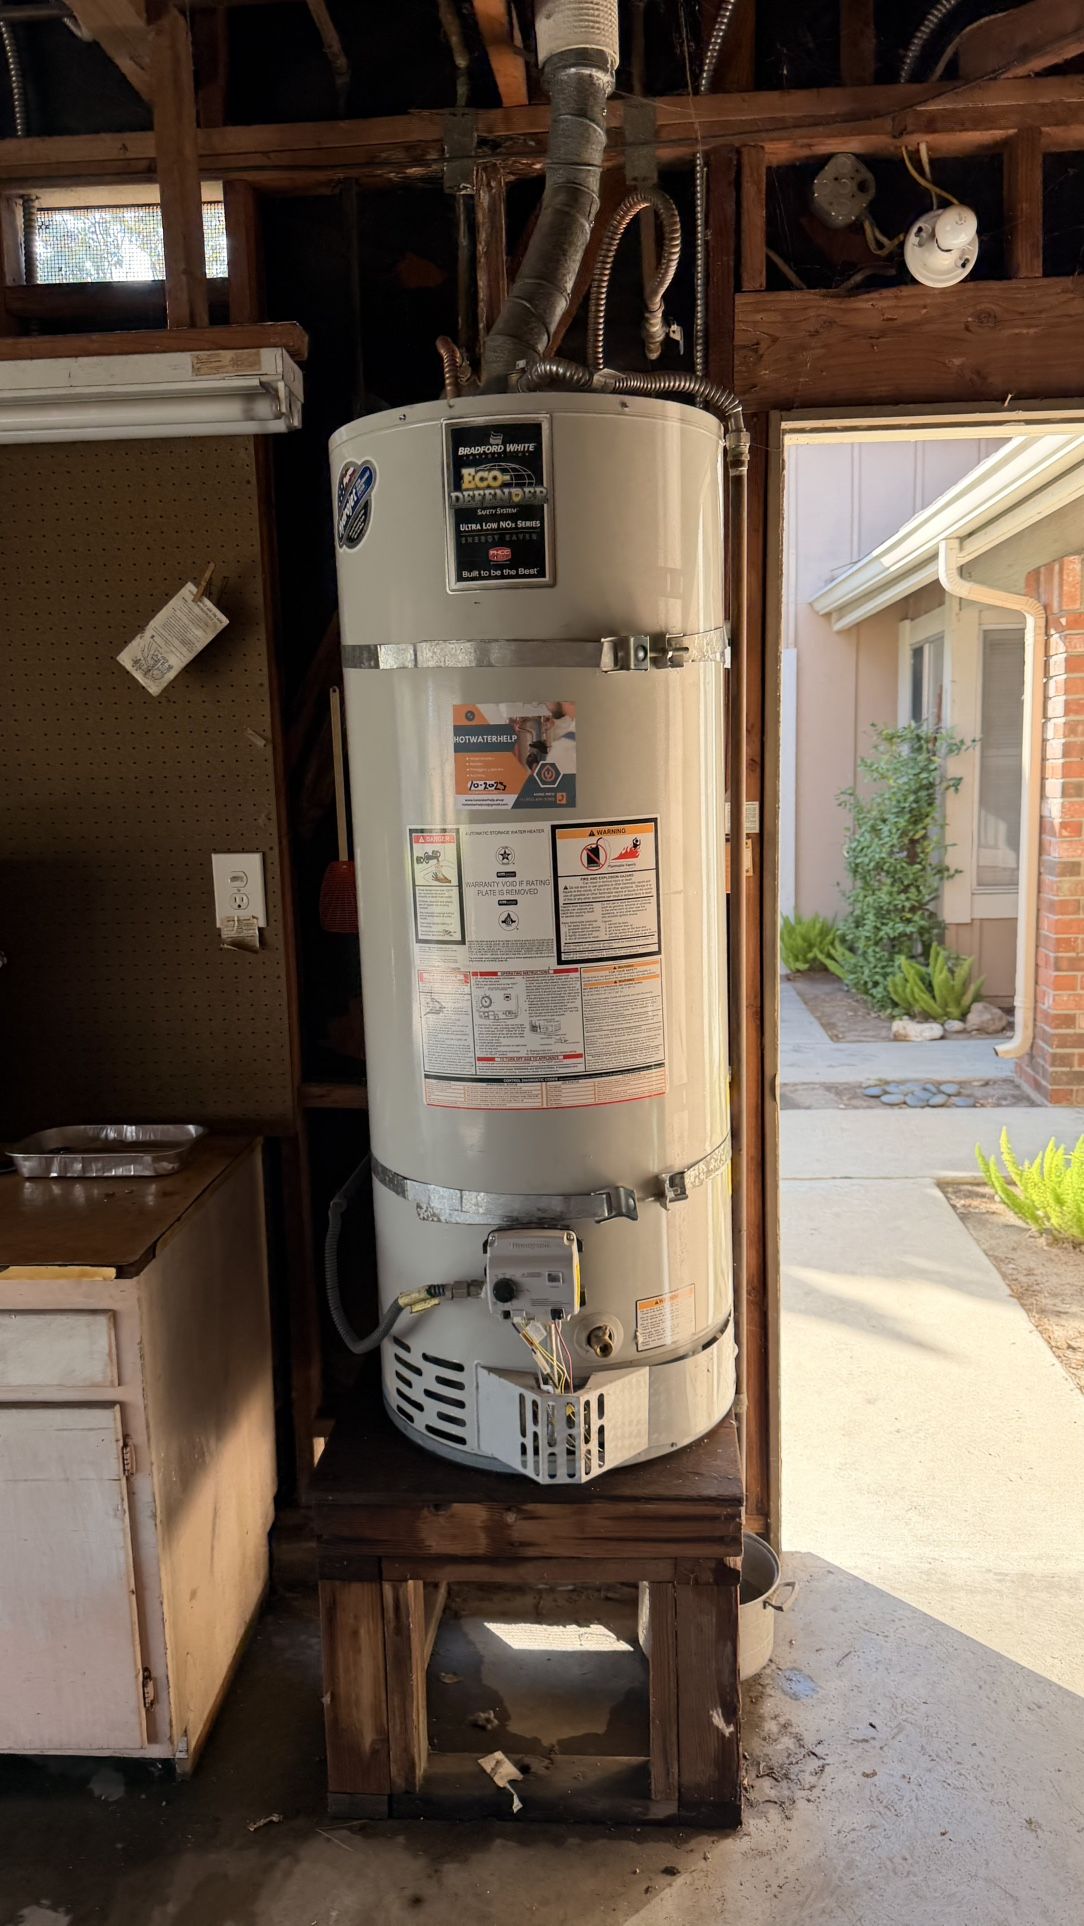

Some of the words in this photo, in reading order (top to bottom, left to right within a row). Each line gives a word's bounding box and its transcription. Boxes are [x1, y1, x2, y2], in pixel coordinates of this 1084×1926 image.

[458, 445, 504, 456] BRADFORD
[506, 443, 535, 452] WHITE
[450, 487, 548, 508] DEFENDER
[482, 522, 498, 530] LOW
[517, 520, 541, 528] SERIES
[462, 570, 479, 578] Built
[518, 567, 537, 575] Best
[453, 735, 518, 743] HOTWATERHELP
[596, 828, 626, 836] WARNING
[501, 880, 517, 888] VOID
[525, 879, 551, 887] RATING
